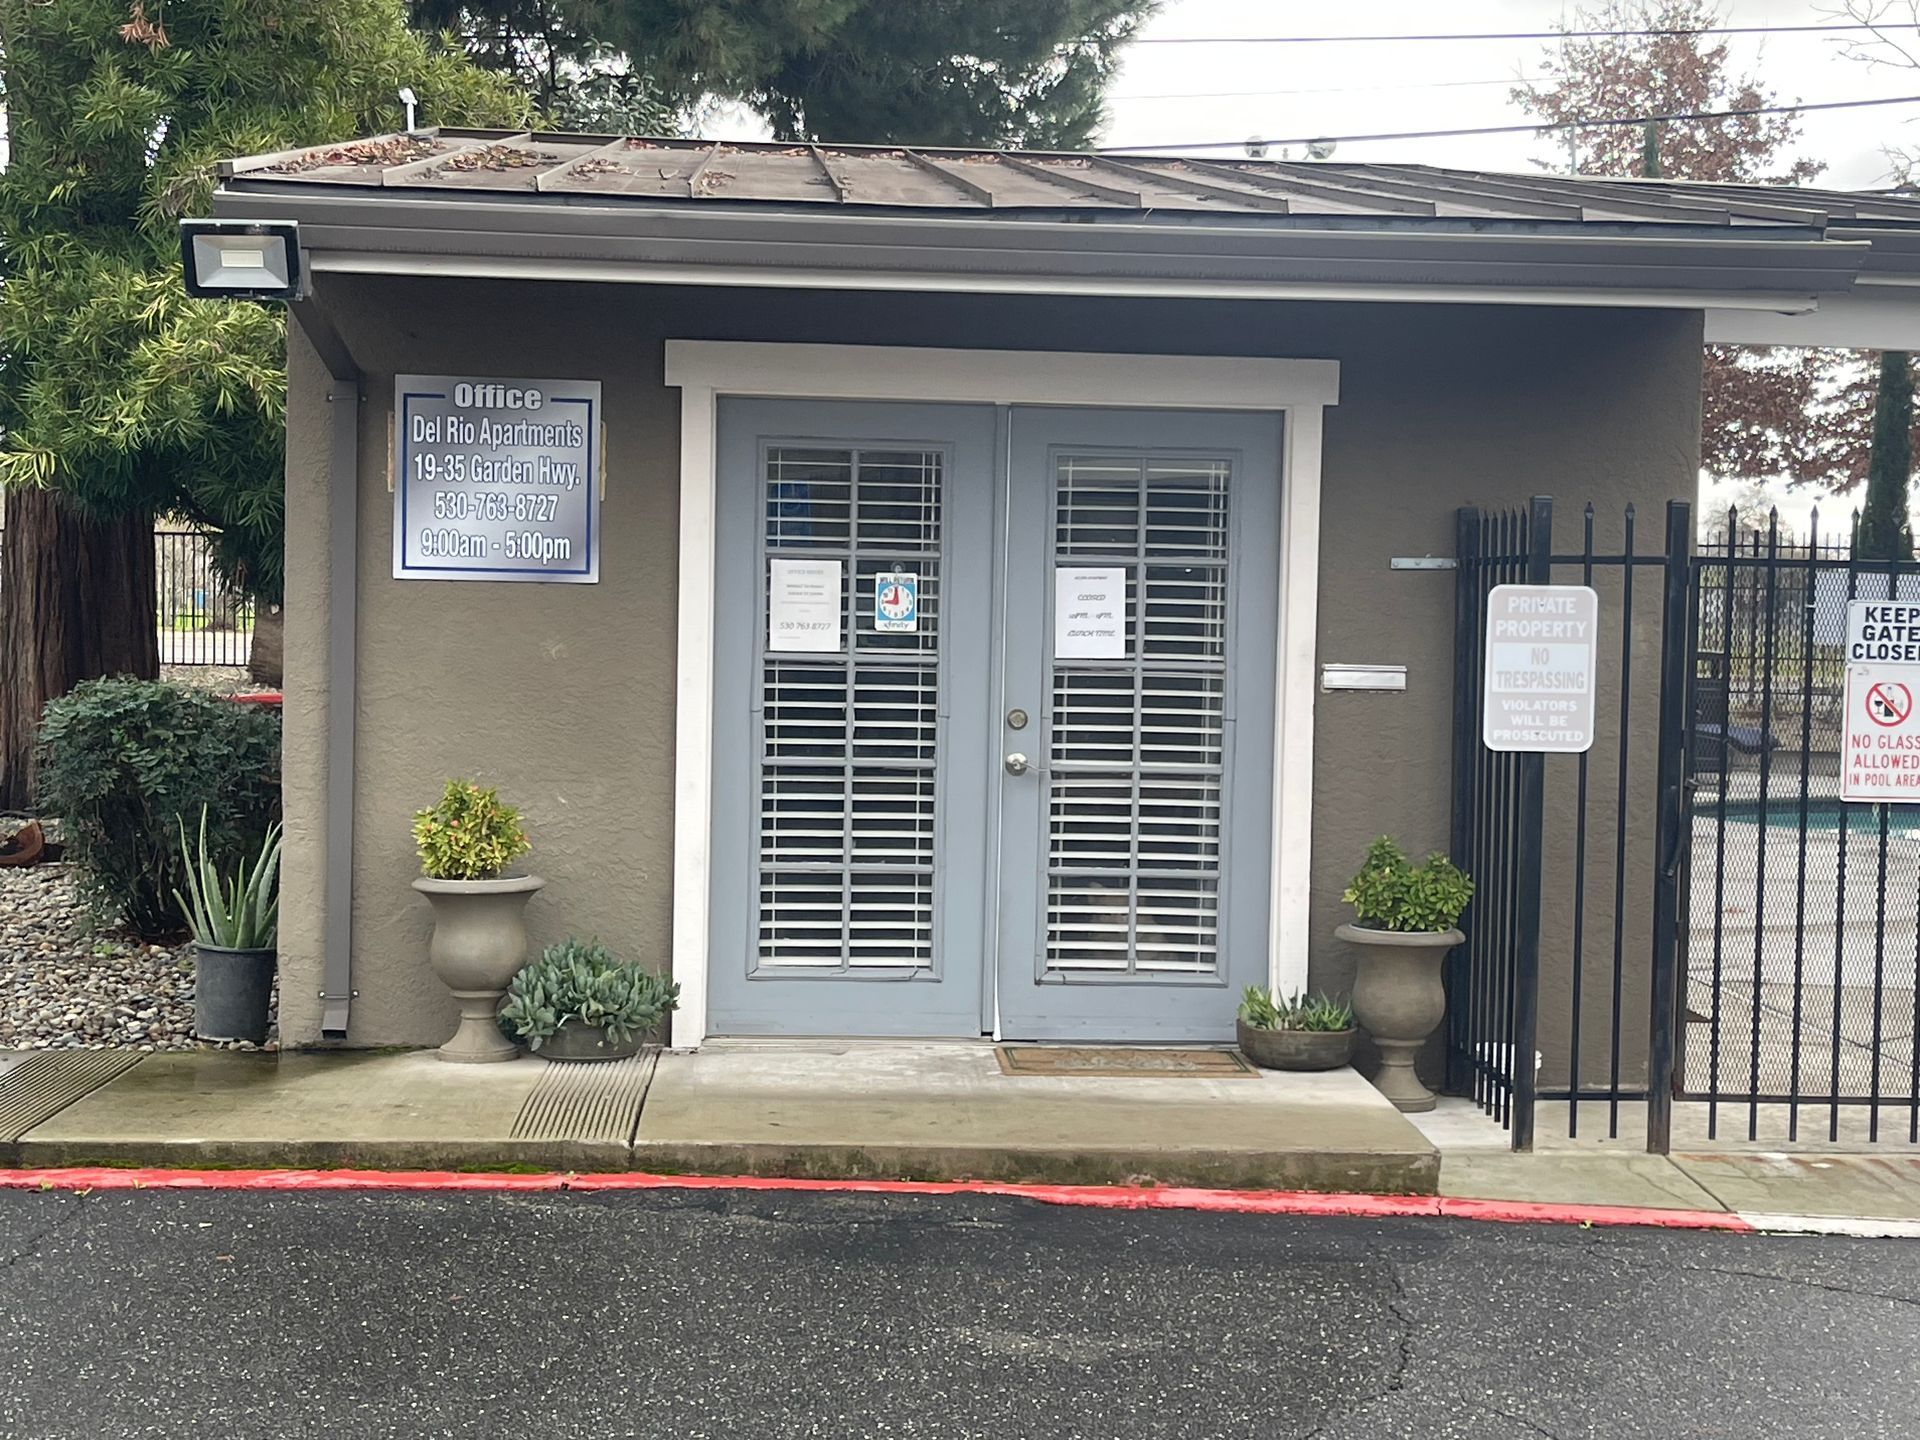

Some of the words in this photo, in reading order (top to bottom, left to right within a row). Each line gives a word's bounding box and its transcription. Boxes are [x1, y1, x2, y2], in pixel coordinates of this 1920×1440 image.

[454, 383, 542, 410] Office
[413, 415, 441, 443] Del
[446, 416, 475, 445] Rio
[479, 417, 583, 451] Apartments
[414, 453, 465, 482] 19-35
[471, 454, 533, 484] Garden
[538, 456, 581, 491] Hwy.
[434, 491, 559, 522] 530-763-8727
[421, 528, 487, 558] 9:00am
[505, 531, 571, 565] 5:00pm
[1508, 596, 1577, 614] PRIVATE
[1865, 606, 1920, 624] KEEP
[1495, 620, 1587, 638] PROPERTY
[1862, 625, 1920, 642] GATE
[1531, 648, 1549, 665] NO
[1852, 643, 1920, 661] CLOSE
[1496, 671, 1584, 689] TRESPASSING
[1501, 700, 1578, 712] VIOLATORS
[1510, 715, 1544, 726] WILL
[1550, 715, 1568, 727] BE
[1493, 730, 1584, 742] PROSECUTED
[1852, 734, 1871, 749] NO
[1878, 734, 1920, 750] GLASS
[1853, 754, 1920, 769] ALLOWED
[1849, 773, 1859, 786] IN
[1865, 773, 1891, 786] POOL
[1895, 773, 1920, 787] AREA
